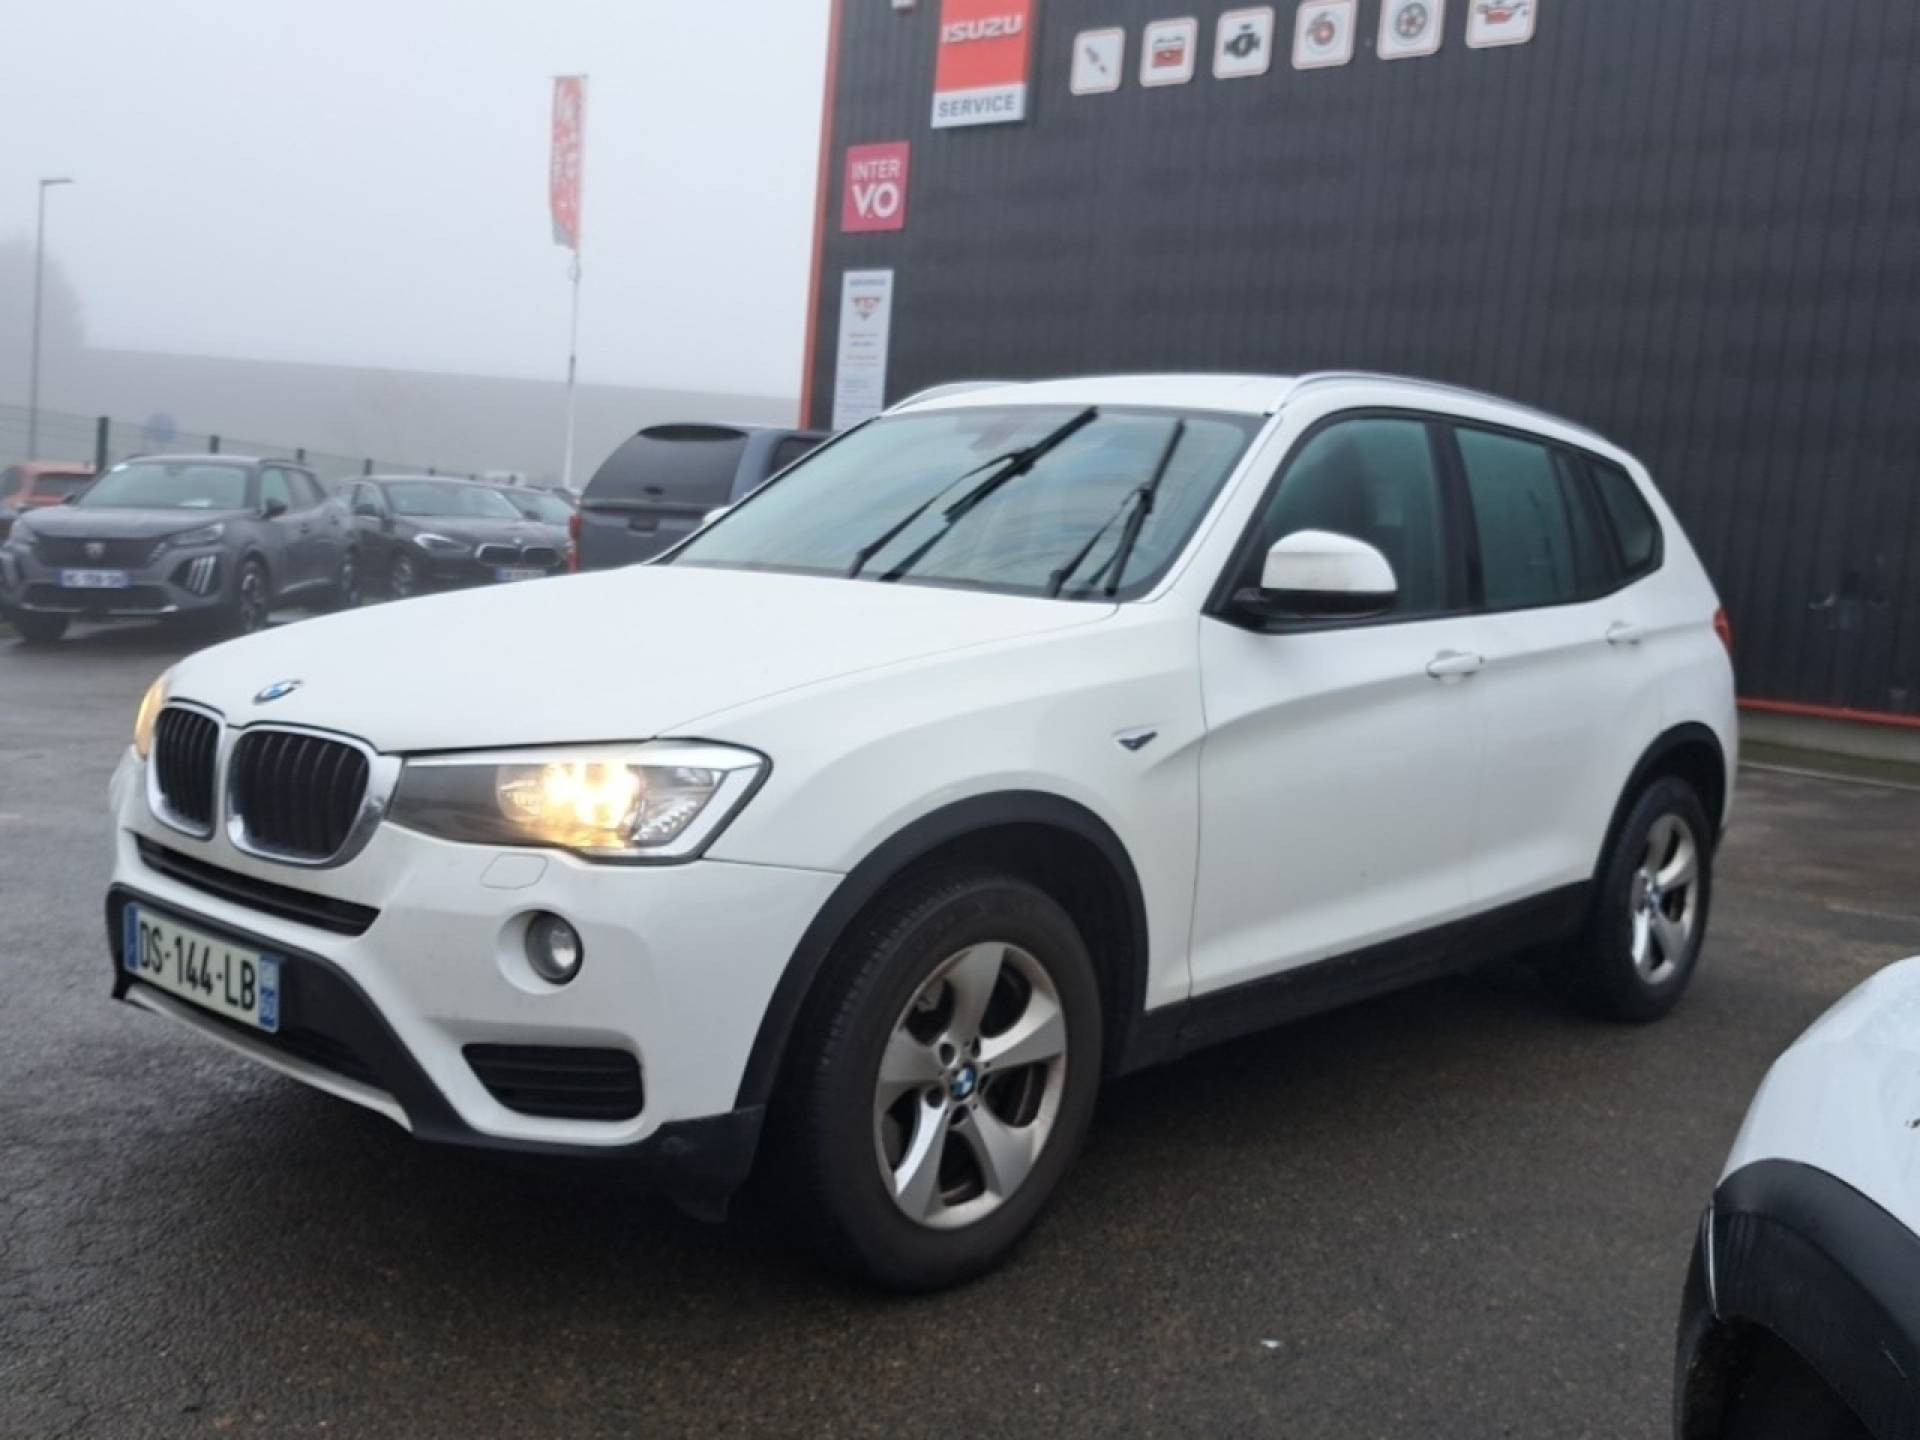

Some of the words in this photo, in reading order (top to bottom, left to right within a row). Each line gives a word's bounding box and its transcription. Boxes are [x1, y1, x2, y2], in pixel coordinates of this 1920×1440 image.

[941, 15, 1024, 43] ISUZU
[938, 95, 1015, 118] SERVICE
[851, 159, 900, 180] INTER
[140, 921, 256, 1011] DS-144-LB
